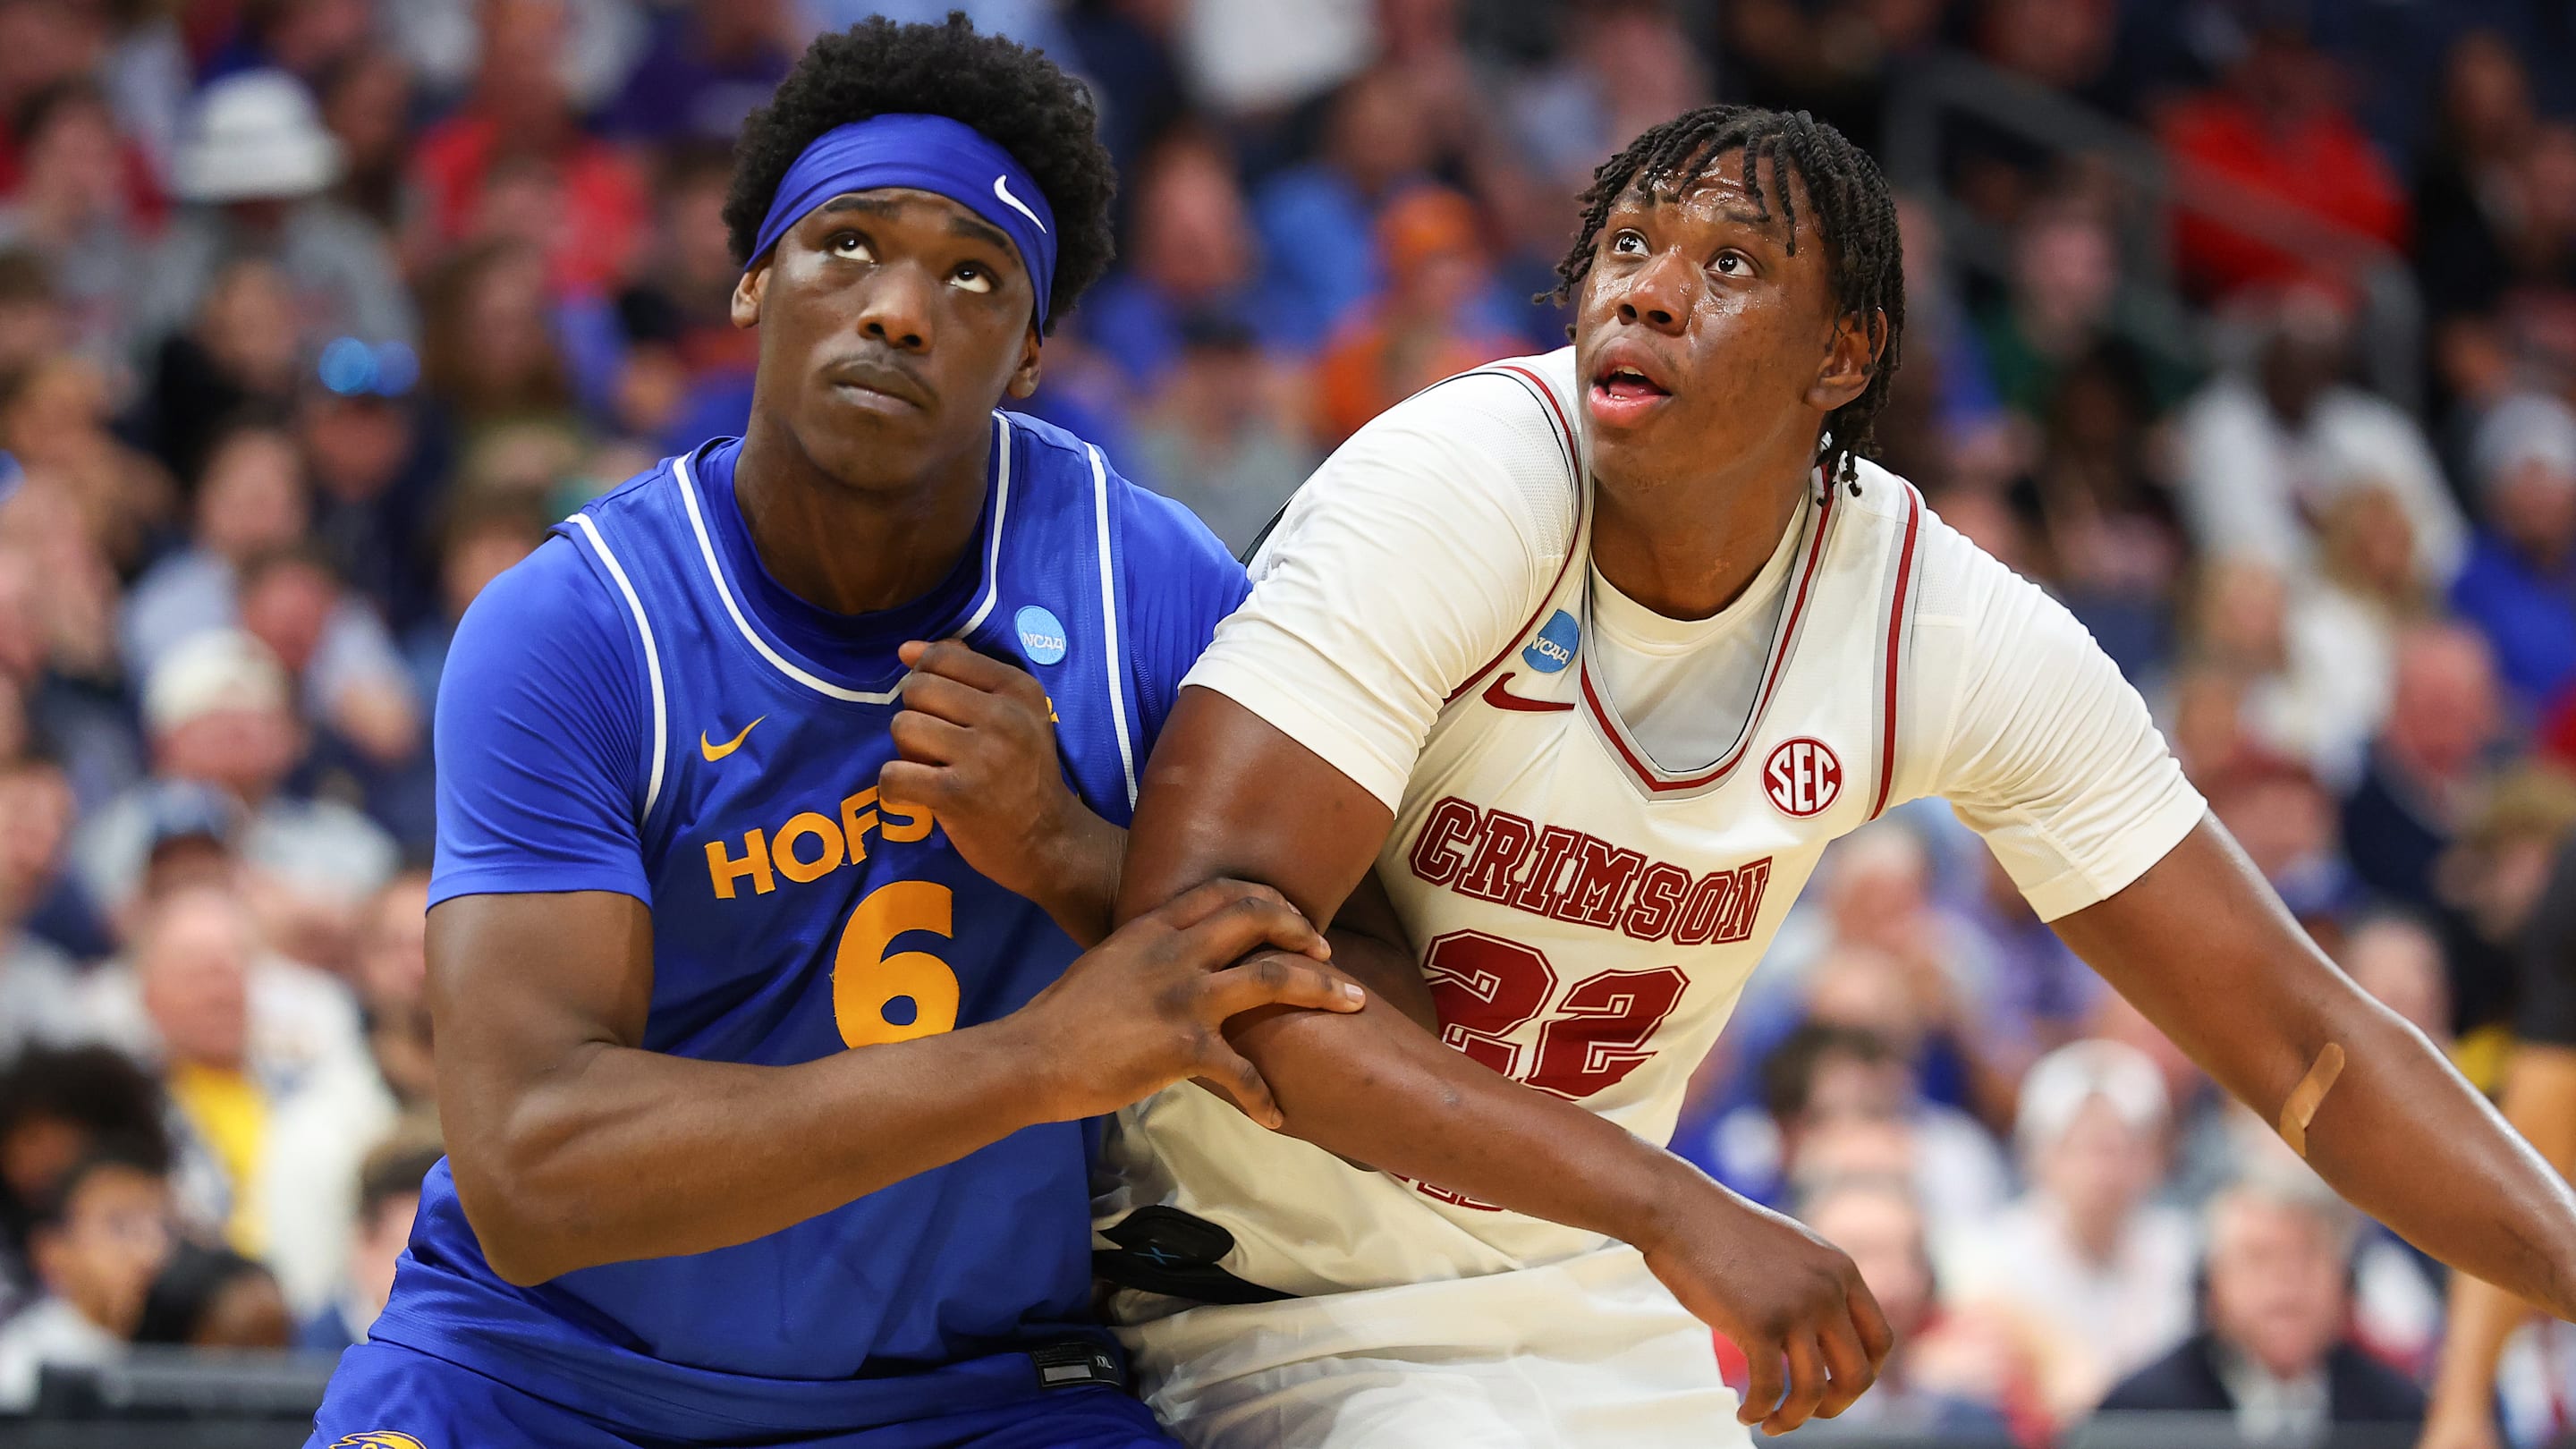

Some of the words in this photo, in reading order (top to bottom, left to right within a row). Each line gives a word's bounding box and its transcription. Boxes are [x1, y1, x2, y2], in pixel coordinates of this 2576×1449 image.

[1022, 631, 1064, 651] NCAA
[1531, 633, 1570, 665] NCAA
[1768, 742, 1836, 812] SEC
[705, 785, 935, 899] HOFS
[1409, 796, 1773, 945] CRIMSON
[833, 880, 961, 1048] 6
[1422, 928, 1690, 1102] 22
